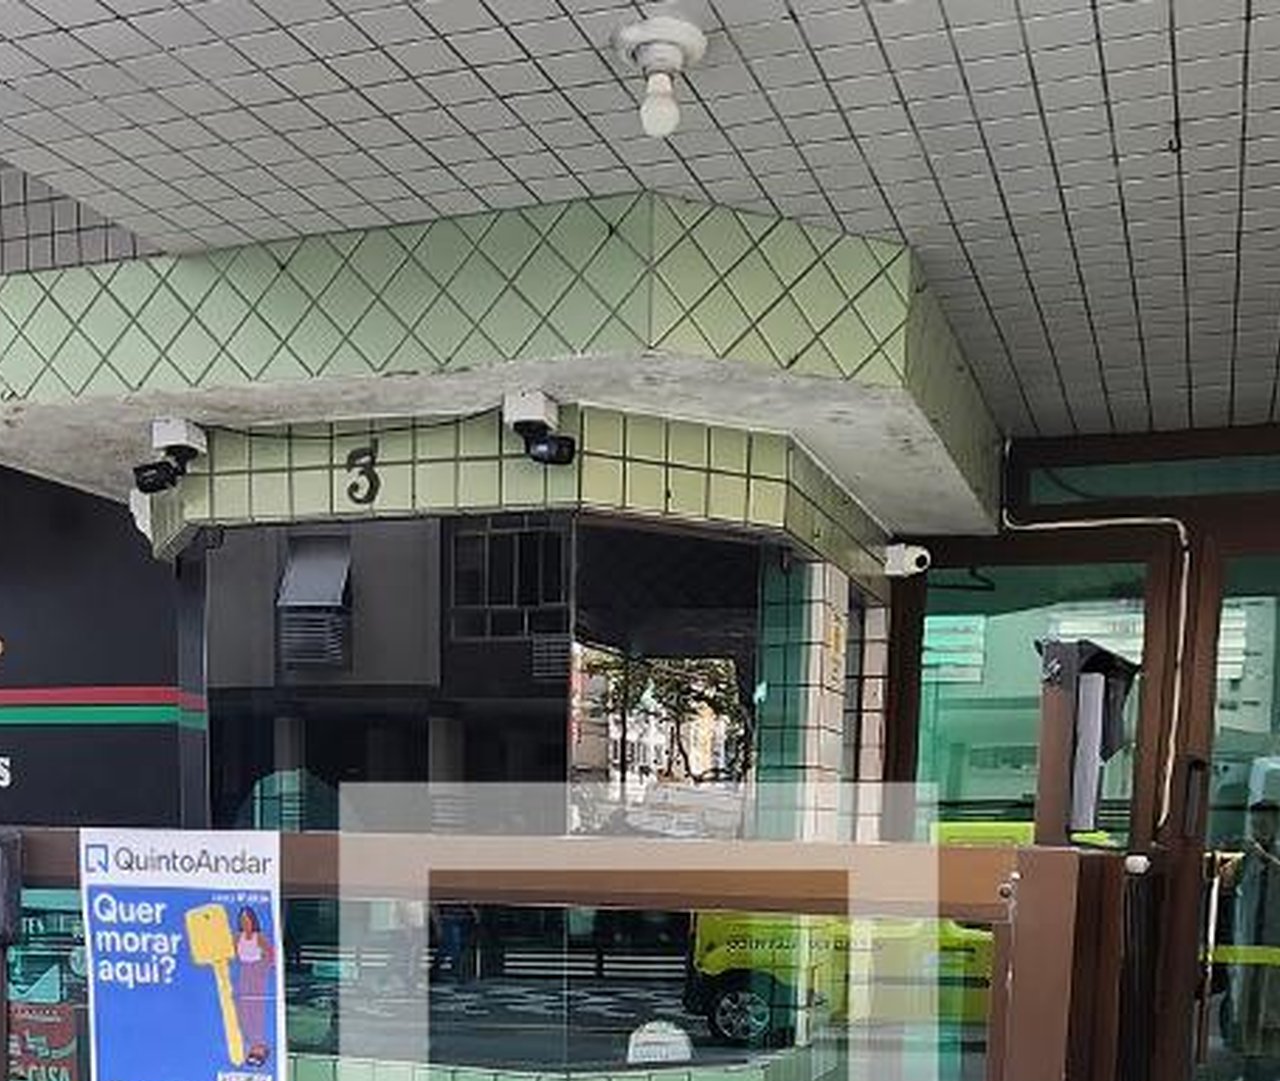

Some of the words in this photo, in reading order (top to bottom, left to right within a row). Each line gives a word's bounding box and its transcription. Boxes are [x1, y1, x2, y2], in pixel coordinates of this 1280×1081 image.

[346, 437, 381, 504] 3
[114, 846, 272, 875] QuintoAndar
[93, 892, 168, 925] Quer
[95, 929, 183, 955] morar
[98, 955, 177, 989] aqui?
